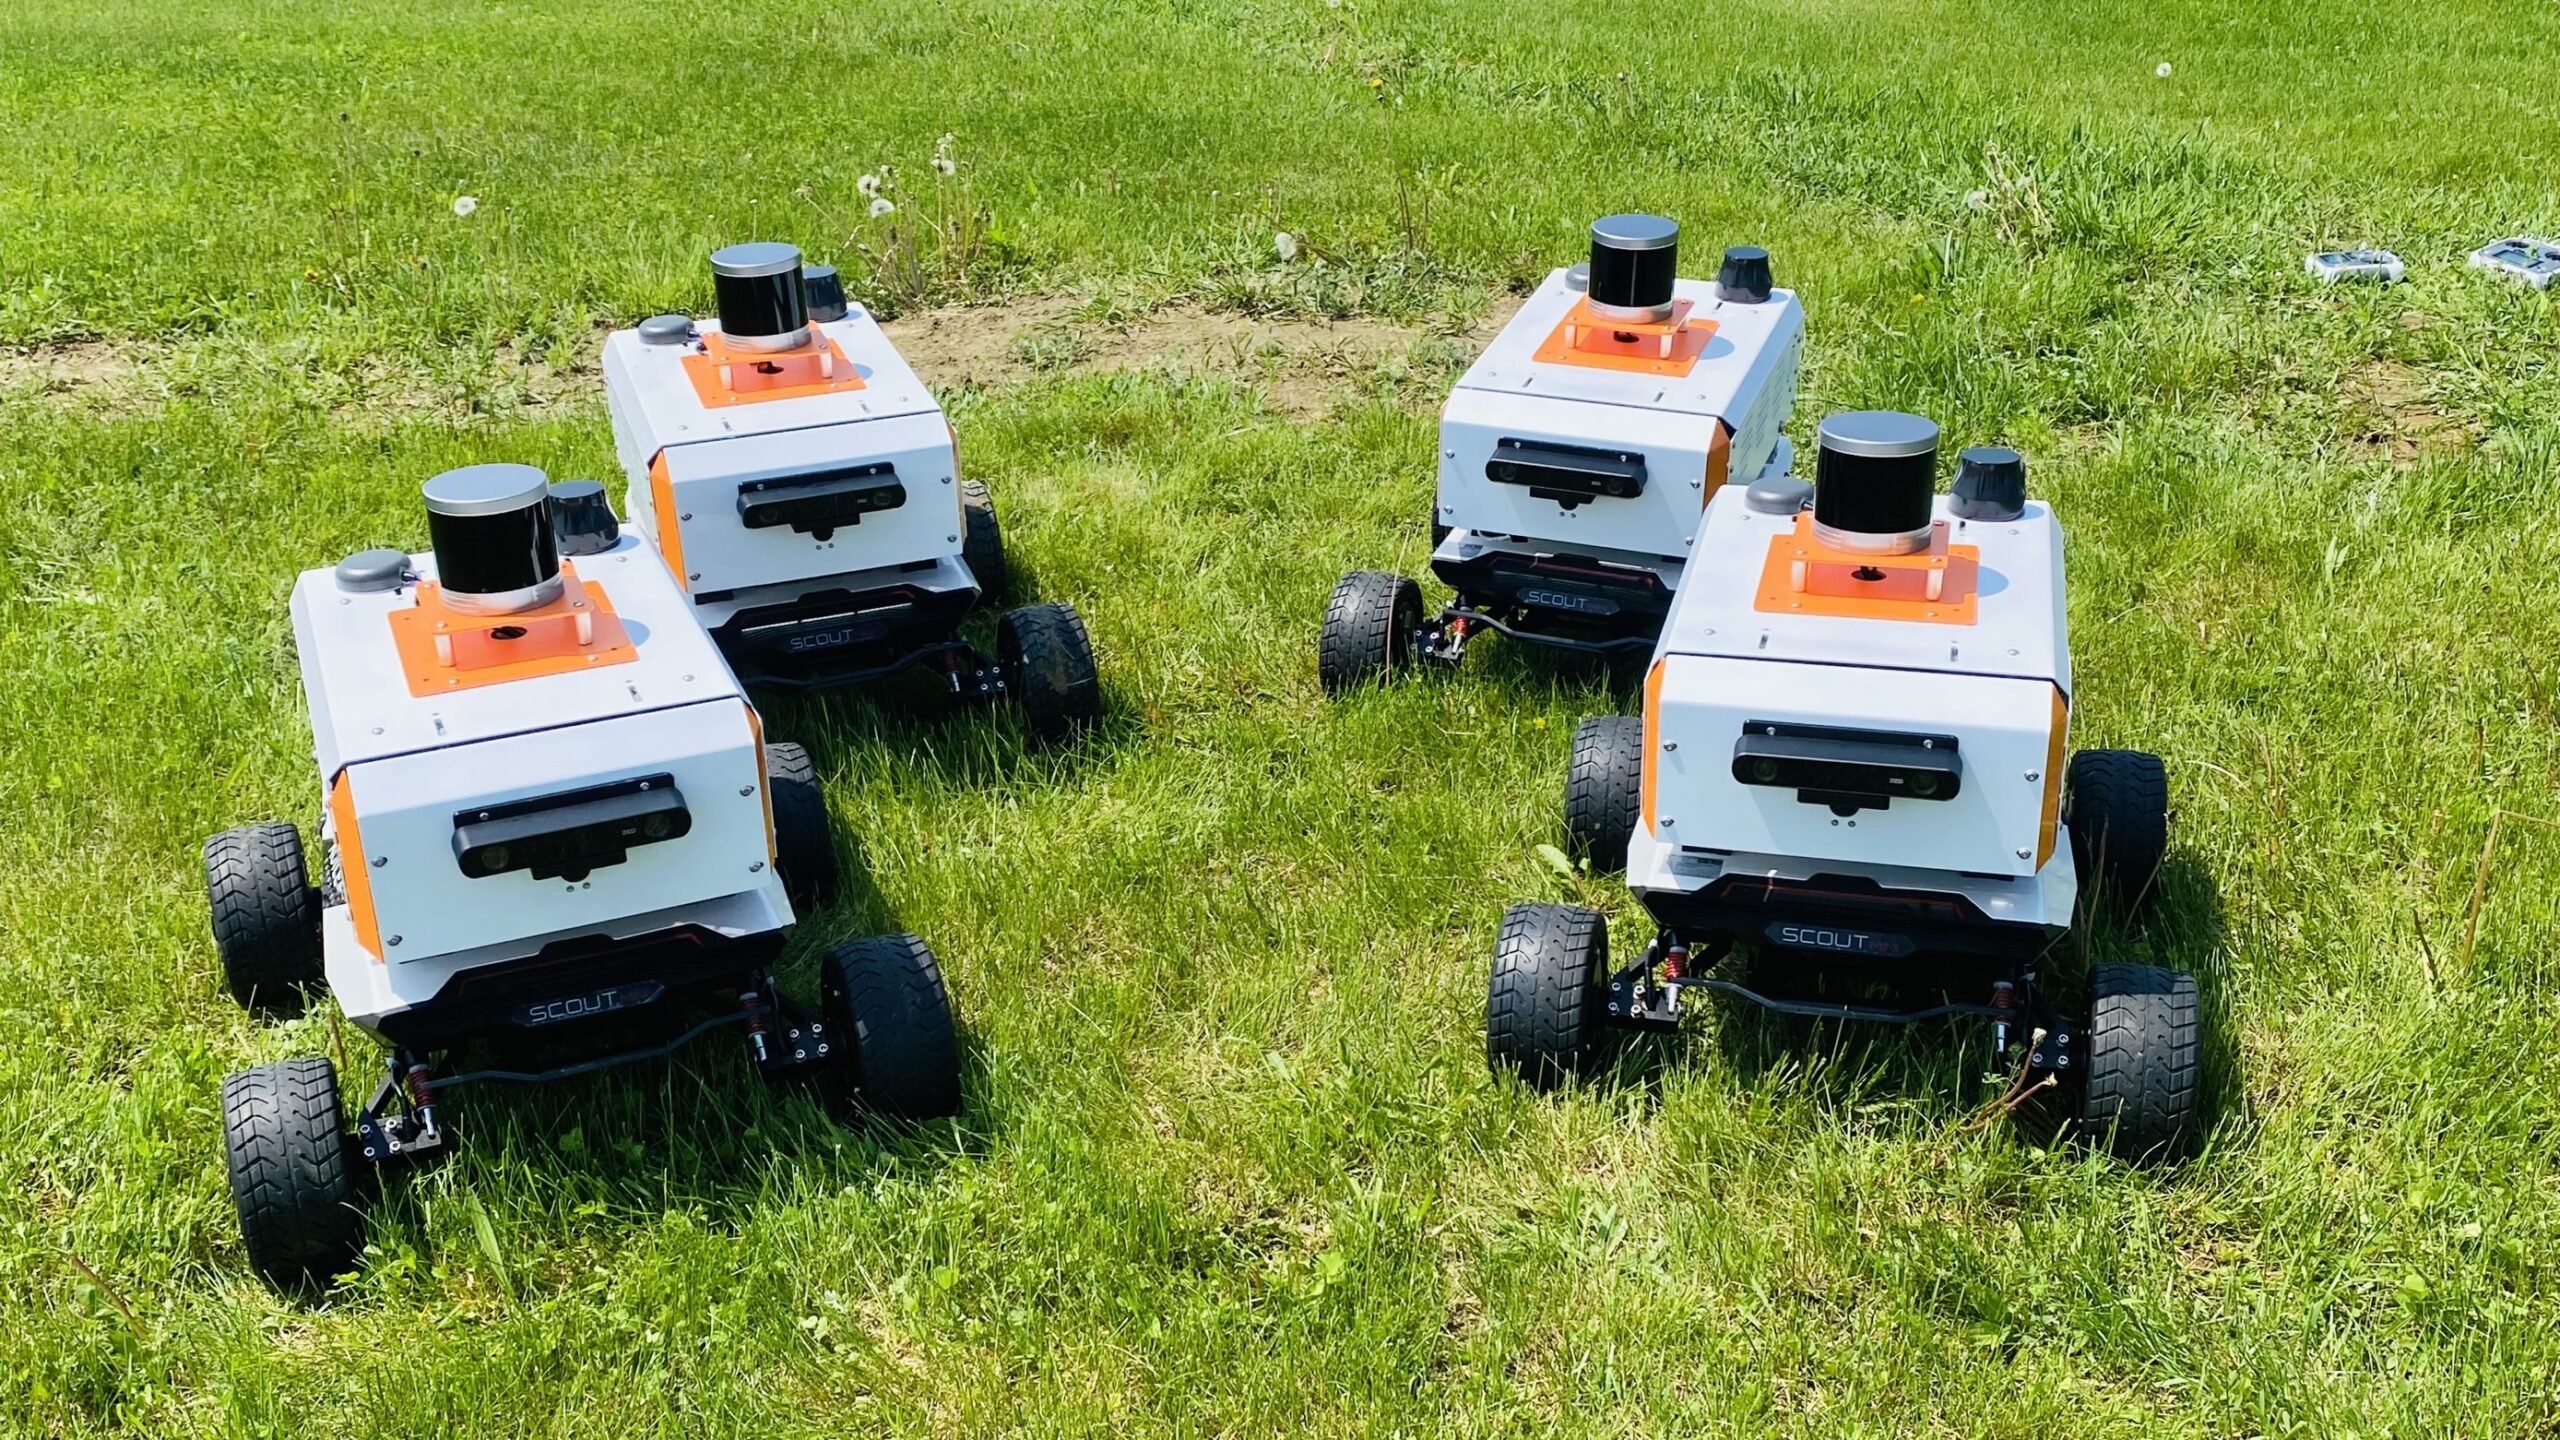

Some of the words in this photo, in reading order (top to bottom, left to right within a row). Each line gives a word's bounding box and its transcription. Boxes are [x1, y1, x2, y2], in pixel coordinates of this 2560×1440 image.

[1528, 590, 1588, 609] SCOUT
[790, 629, 853, 650] SCOUT
[1782, 927, 1869, 949] SCOUT
[529, 990, 617, 1023] SCOUT
